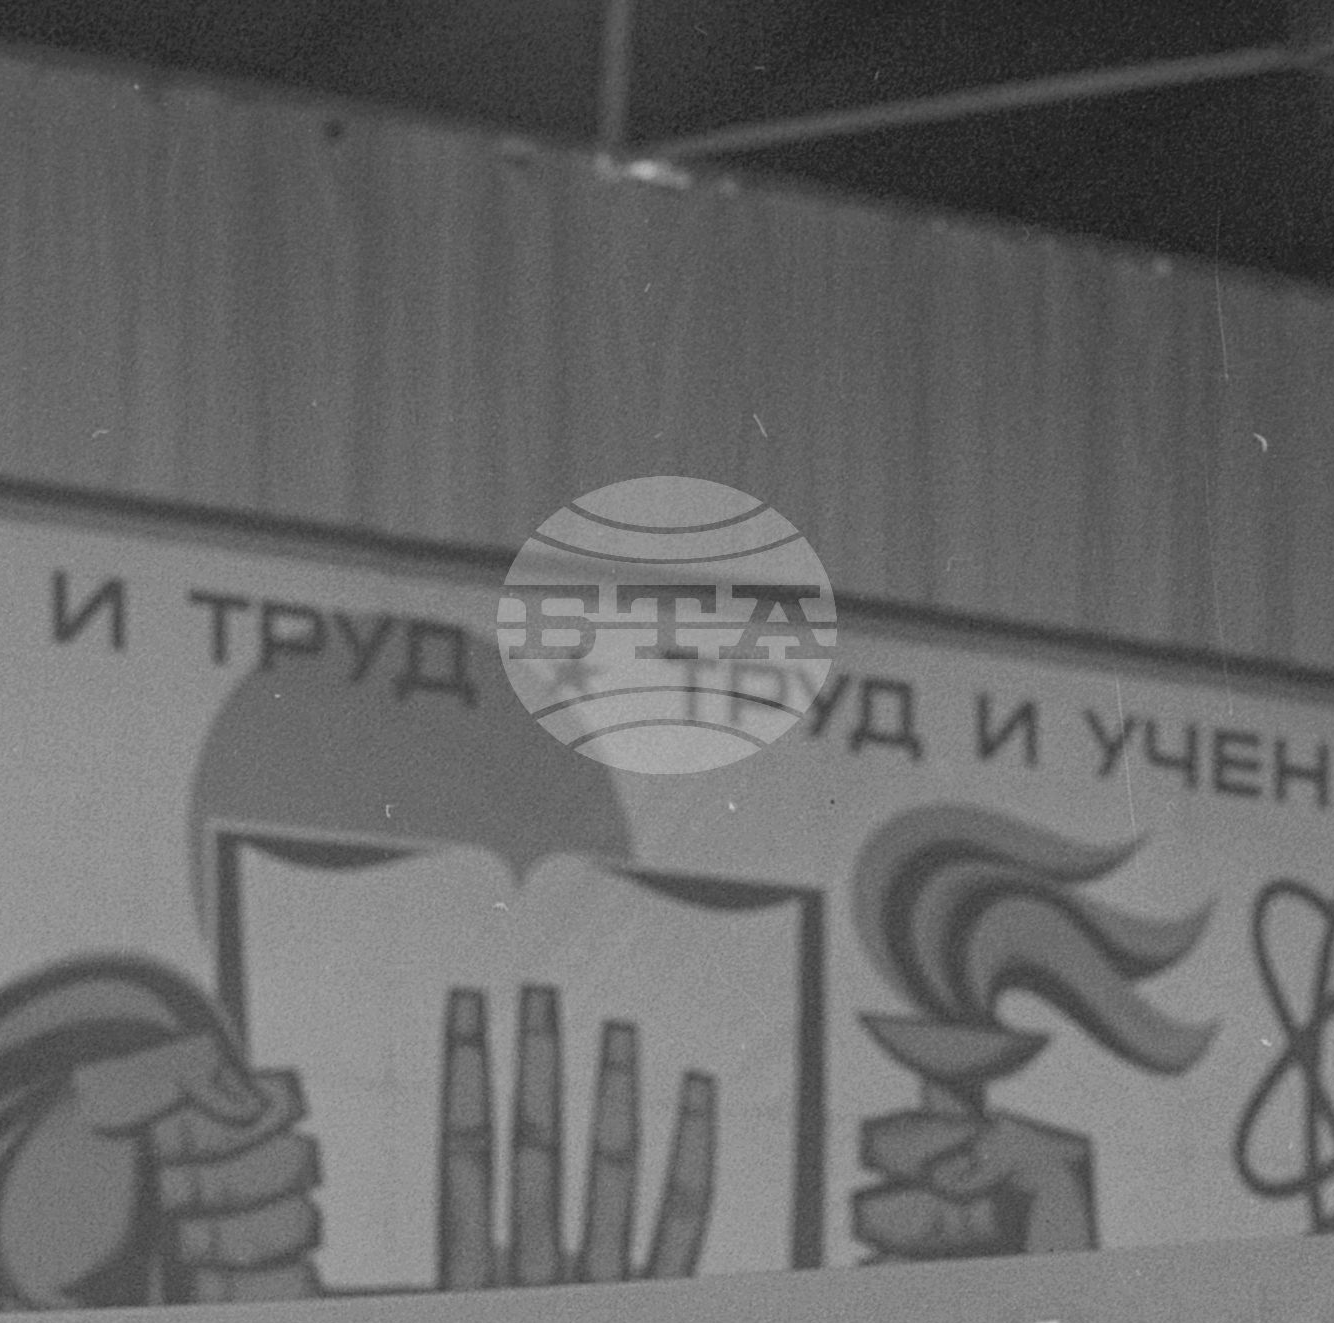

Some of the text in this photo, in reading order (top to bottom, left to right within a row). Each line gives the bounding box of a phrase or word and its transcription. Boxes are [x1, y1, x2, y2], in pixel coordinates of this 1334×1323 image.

[52, 568, 127, 654] И
[189, 588, 479, 712] ТРУД
[661, 650, 925, 766] ТРУД
[974, 688, 1041, 768] И
